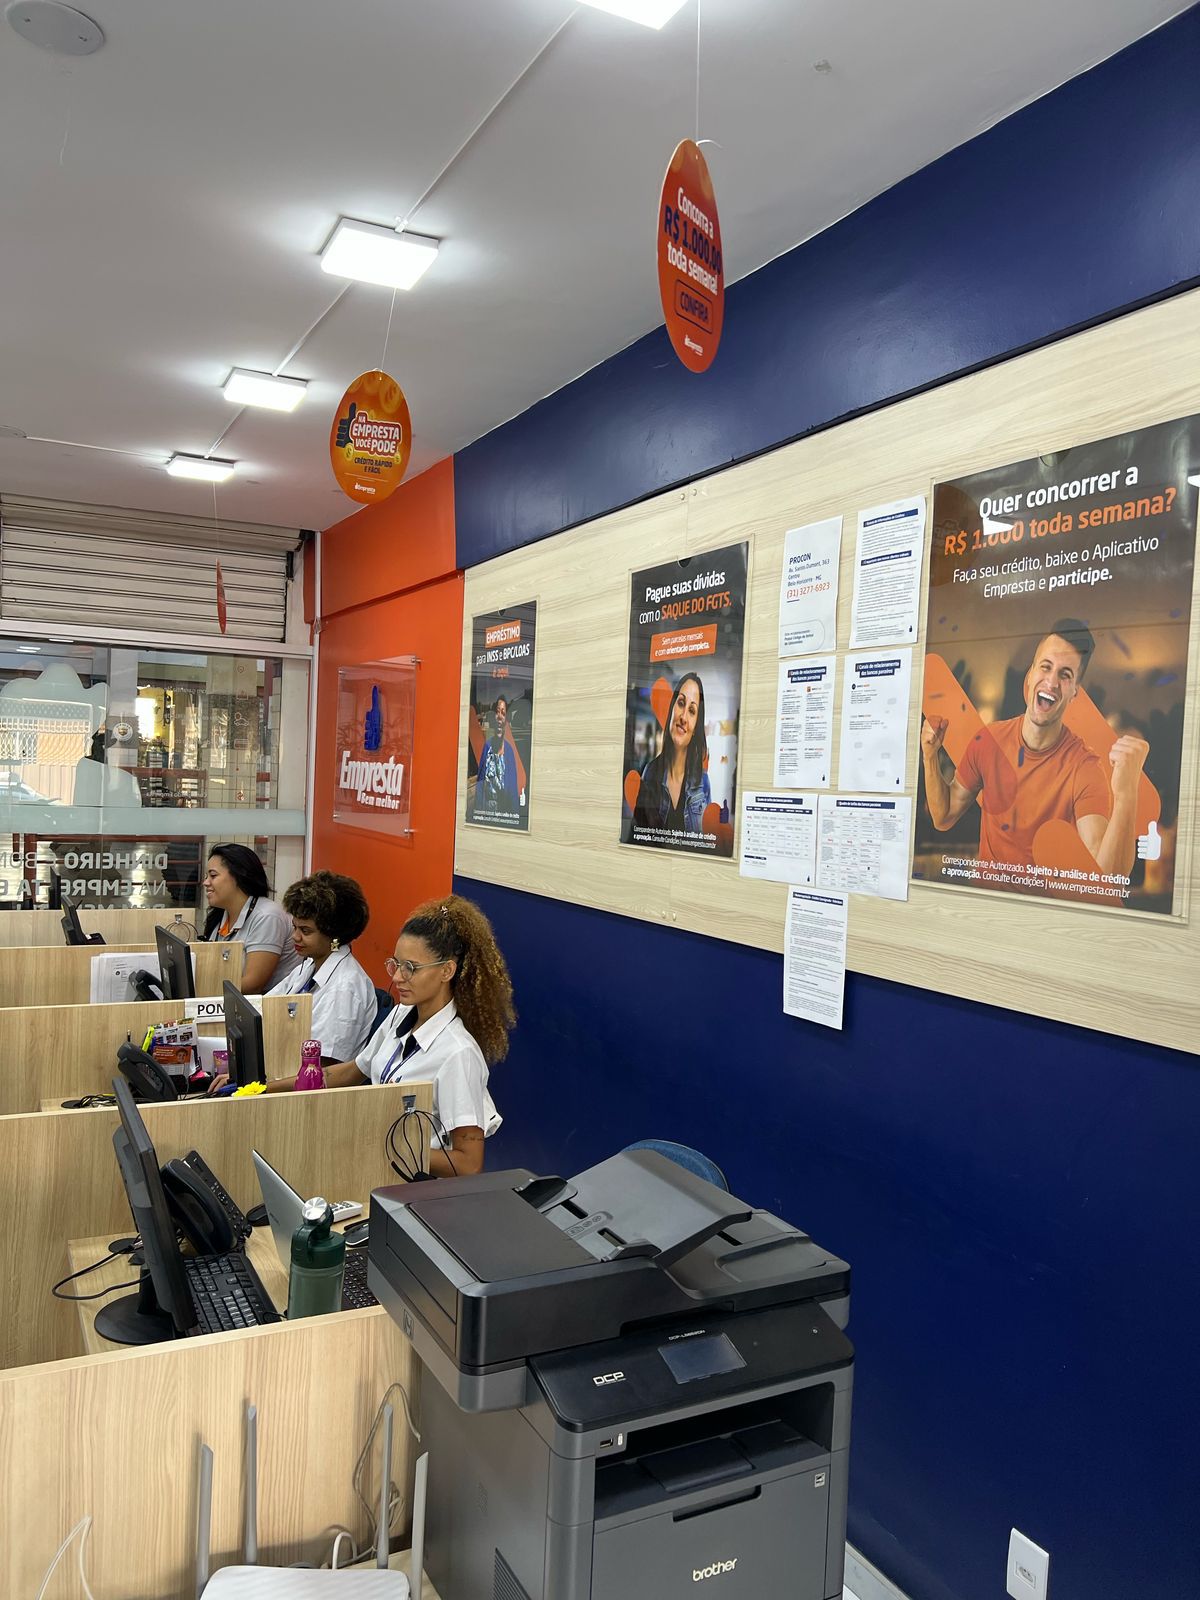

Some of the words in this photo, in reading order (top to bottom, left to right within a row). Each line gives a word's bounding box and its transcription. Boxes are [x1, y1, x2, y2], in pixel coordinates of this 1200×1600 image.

[678, 187, 708, 235] Concorra
[710, 222, 714, 239] a
[664, 204, 680, 245] R$
[682, 221, 721, 275] 1.000,00
[668, 241, 687, 274] toda
[688, 259, 718, 296] semana!
[680, 291, 709, 321] CONFIRA
[352, 424, 400, 440] EMPRESTA
[356, 438, 371, 448] VOCÊ
[371, 439, 396, 453] PODE
[355, 457, 374, 466] CRÉDITO
[375, 459, 392, 468] RÁPIDO
[980, 493, 1023, 519] Quer
[1026, 469, 1121, 508] concorrer
[1125, 466, 1139, 486] a
[944, 530, 968, 556] R$
[1029, 513, 1073, 539] toda
[1078, 487, 1177, 529] semana?
[790, 553, 811, 565] PROCON
[952, 568, 977, 584] Faça
[980, 566, 999, 580] seu
[1002, 555, 1042, 575] crédito,
[1046, 549, 1078, 569] baixe
[1081, 550, 1090, 562] o
[1092, 536, 1159, 563] Aplicativo
[646, 587, 671, 603] Pague
[672, 581, 692, 596] suas
[693, 570, 726, 591] dívidas
[787, 589, 799, 600] (31)
[984, 578, 1035, 599] Empresta
[1038, 578, 1046, 590] e
[1048, 566, 1113, 591] participe.
[640, 611, 654, 624] com
[655, 609, 660, 621] o
[662, 599, 690, 620] SAQUE
[691, 597, 705, 614] DO
[706, 591, 732, 611] FGTS.
[486, 626, 520, 644] EMPRÉSTIMO
[476, 654, 486, 667] para
[486, 650, 498, 663] INSS
[499, 652, 503, 661] e
[503, 644, 530, 660] BPC/LOAS
[338, 750, 404, 802] Empresta
[361, 792, 374, 806] Bem
[376, 795, 400, 810] melhor
[942, 854, 988, 870] Correspondente
[990, 859, 1025, 874] Autorizado.
[1026, 864, 1052, 878] Sujeito
[1054, 866, 1059, 877] à
[1060, 867, 1088, 881] análise
[1089, 870, 1100, 882] de
[1101, 872, 1130, 886] crédito
[942, 868, 946, 876] e
[946, 868, 981, 880] aprovação.
[982, 870, 1010, 883] Consulte
[1011, 874, 1044, 888] Condições
[1048, 880, 1130, 898] www.empresta.com.br
[593, 1371, 625, 1385] DCP
[692, 1558, 738, 1582] brother
